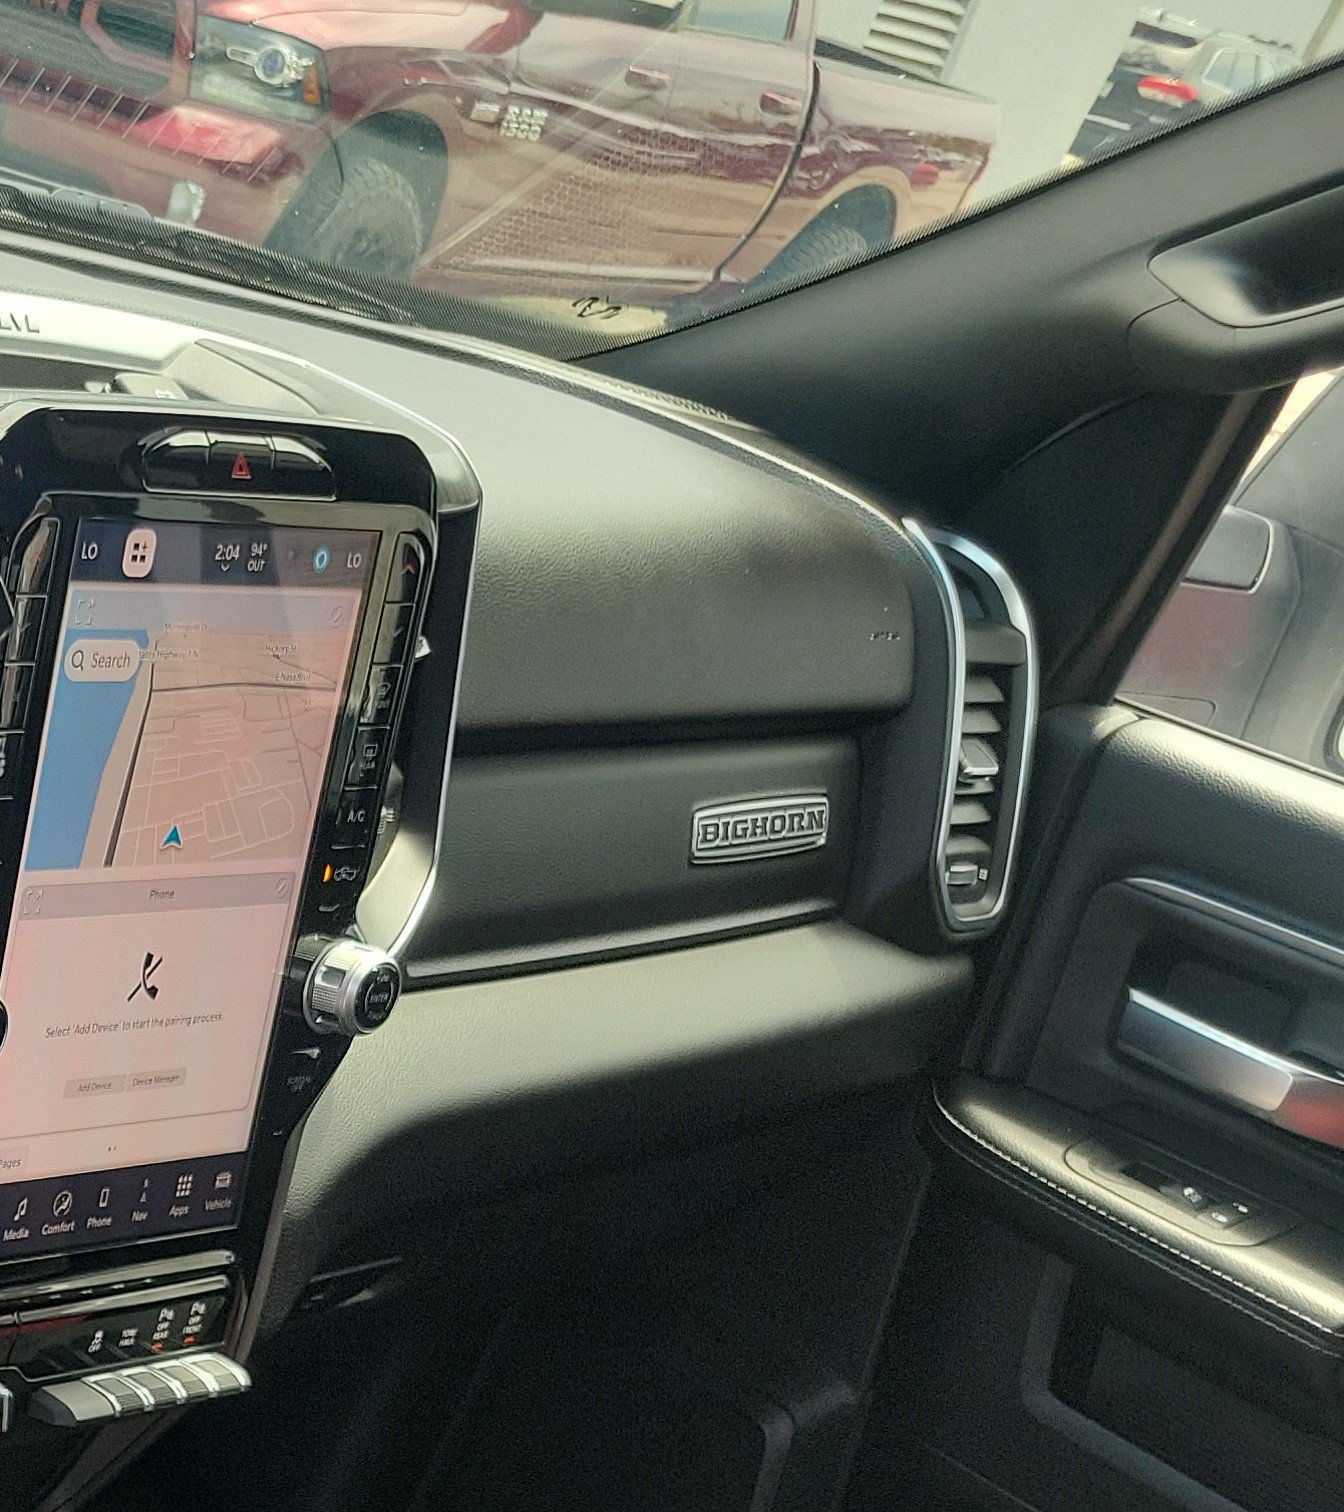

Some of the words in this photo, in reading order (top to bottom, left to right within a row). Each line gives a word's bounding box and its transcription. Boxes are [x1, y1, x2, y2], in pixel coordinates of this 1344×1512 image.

[81, 542, 99, 560] LO
[215, 544, 240, 562] 2:04
[247, 560, 266, 572] OUT
[347, 553, 362, 569] LO
[91, 652, 131, 669] Search
[347, 810, 366, 823] A/C
[699, 810, 826, 849] BIGHORN
[149, 889, 175, 900] Phone
[45, 1026, 71, 1039] Select
[122, 1020, 131, 1031] to
[132, 1018, 150, 1030] start
[151, 1017, 164, 1028] the
[164, 1015, 191, 1028] pairing
[168, 1205, 189, 1217] Apps
[205, 1198, 232, 1211] Vehicle
[87, 1215, 112, 1229] Phone
[132, 1210, 148, 1222] Nav
[3, 1228, 30, 1242] Media
[41, 1221, 75, 1236] Comfort
